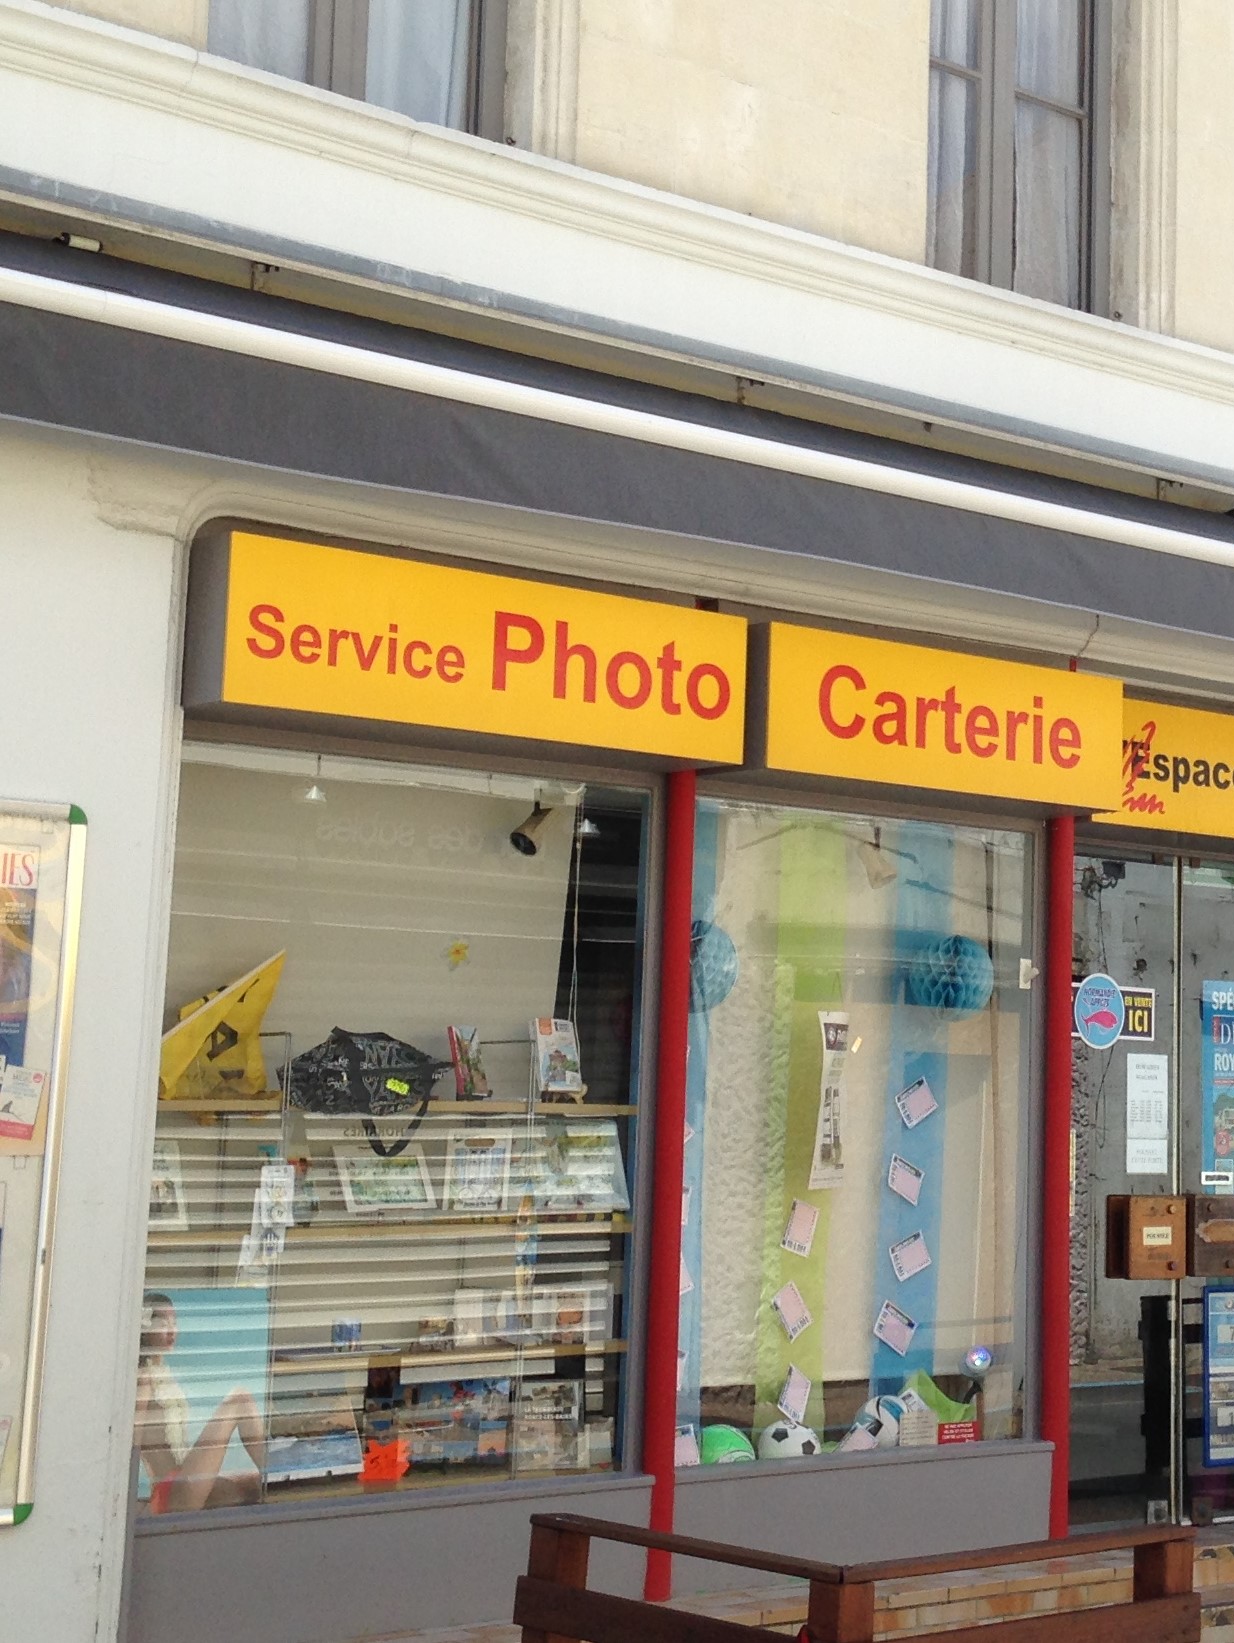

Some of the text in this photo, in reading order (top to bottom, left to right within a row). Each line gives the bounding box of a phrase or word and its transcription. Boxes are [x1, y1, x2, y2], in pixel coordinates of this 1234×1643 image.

[247, 603, 732, 721] Service Photo
[818, 665, 1082, 769] Carterie
[1128, 1009, 1149, 1032] ICI
